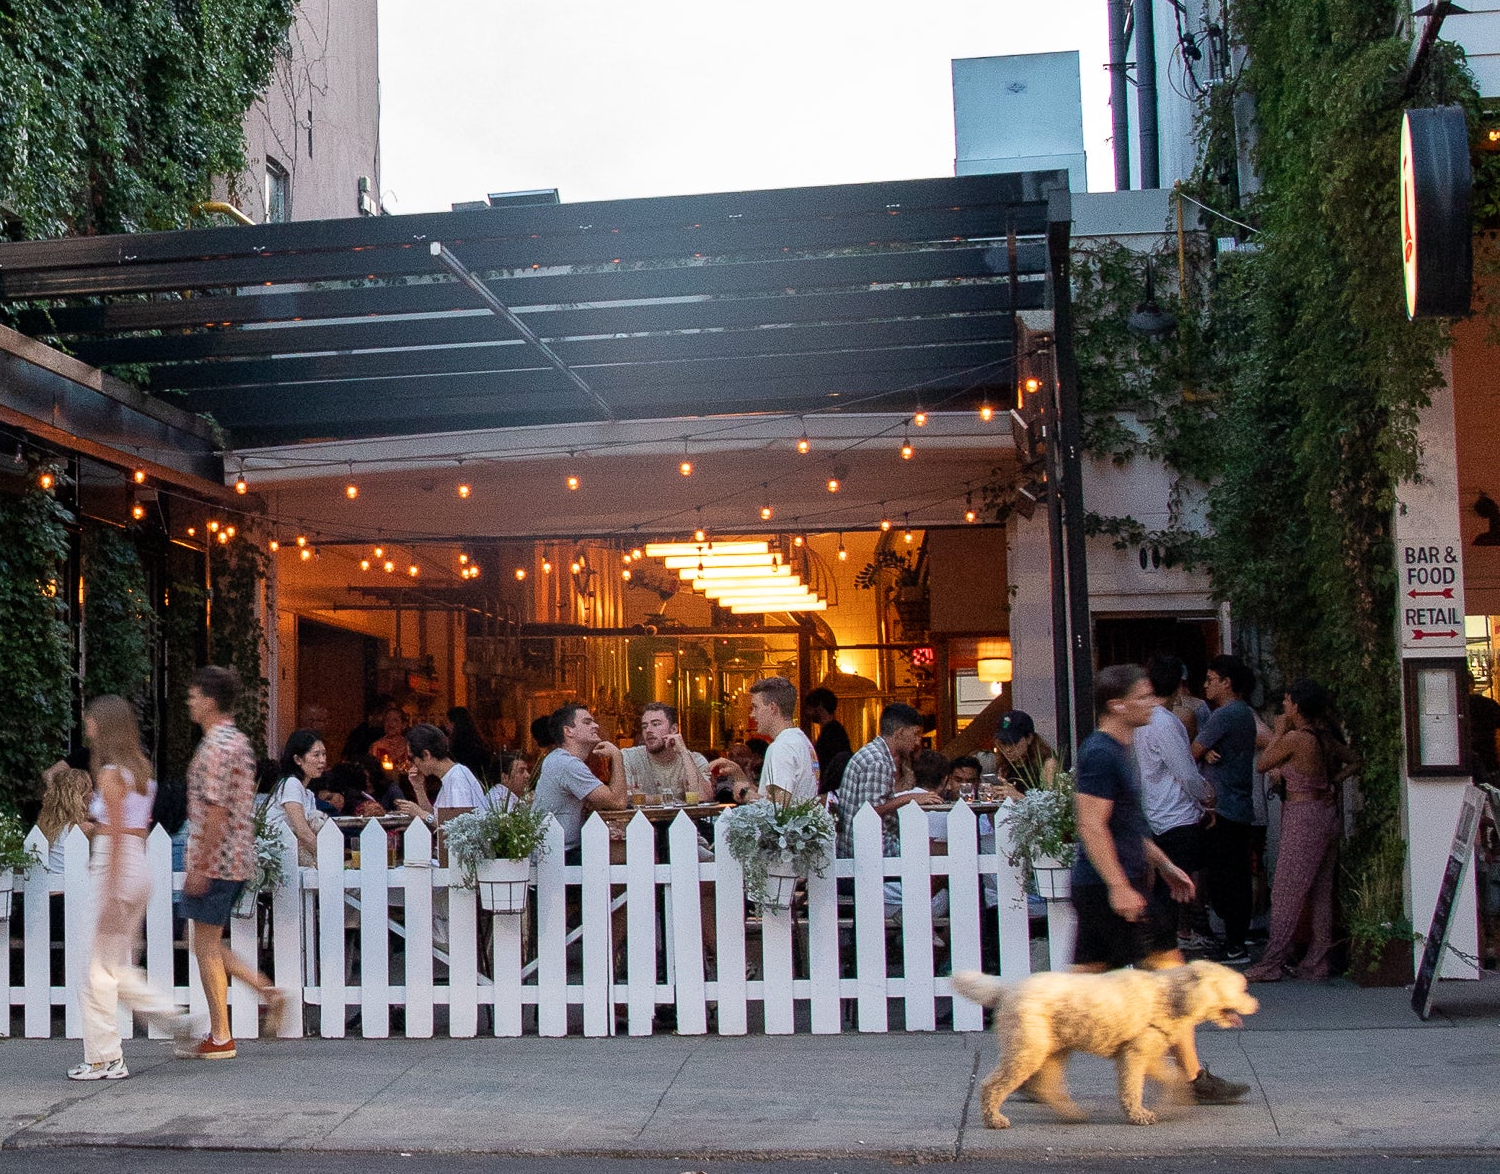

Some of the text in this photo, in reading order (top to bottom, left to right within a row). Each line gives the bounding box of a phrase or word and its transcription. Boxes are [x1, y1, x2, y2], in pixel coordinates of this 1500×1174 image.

[1405, 546, 1458, 564] BAR &
[1407, 567, 1456, 585] FOOD
[1405, 608, 1461, 626] RETAIL
